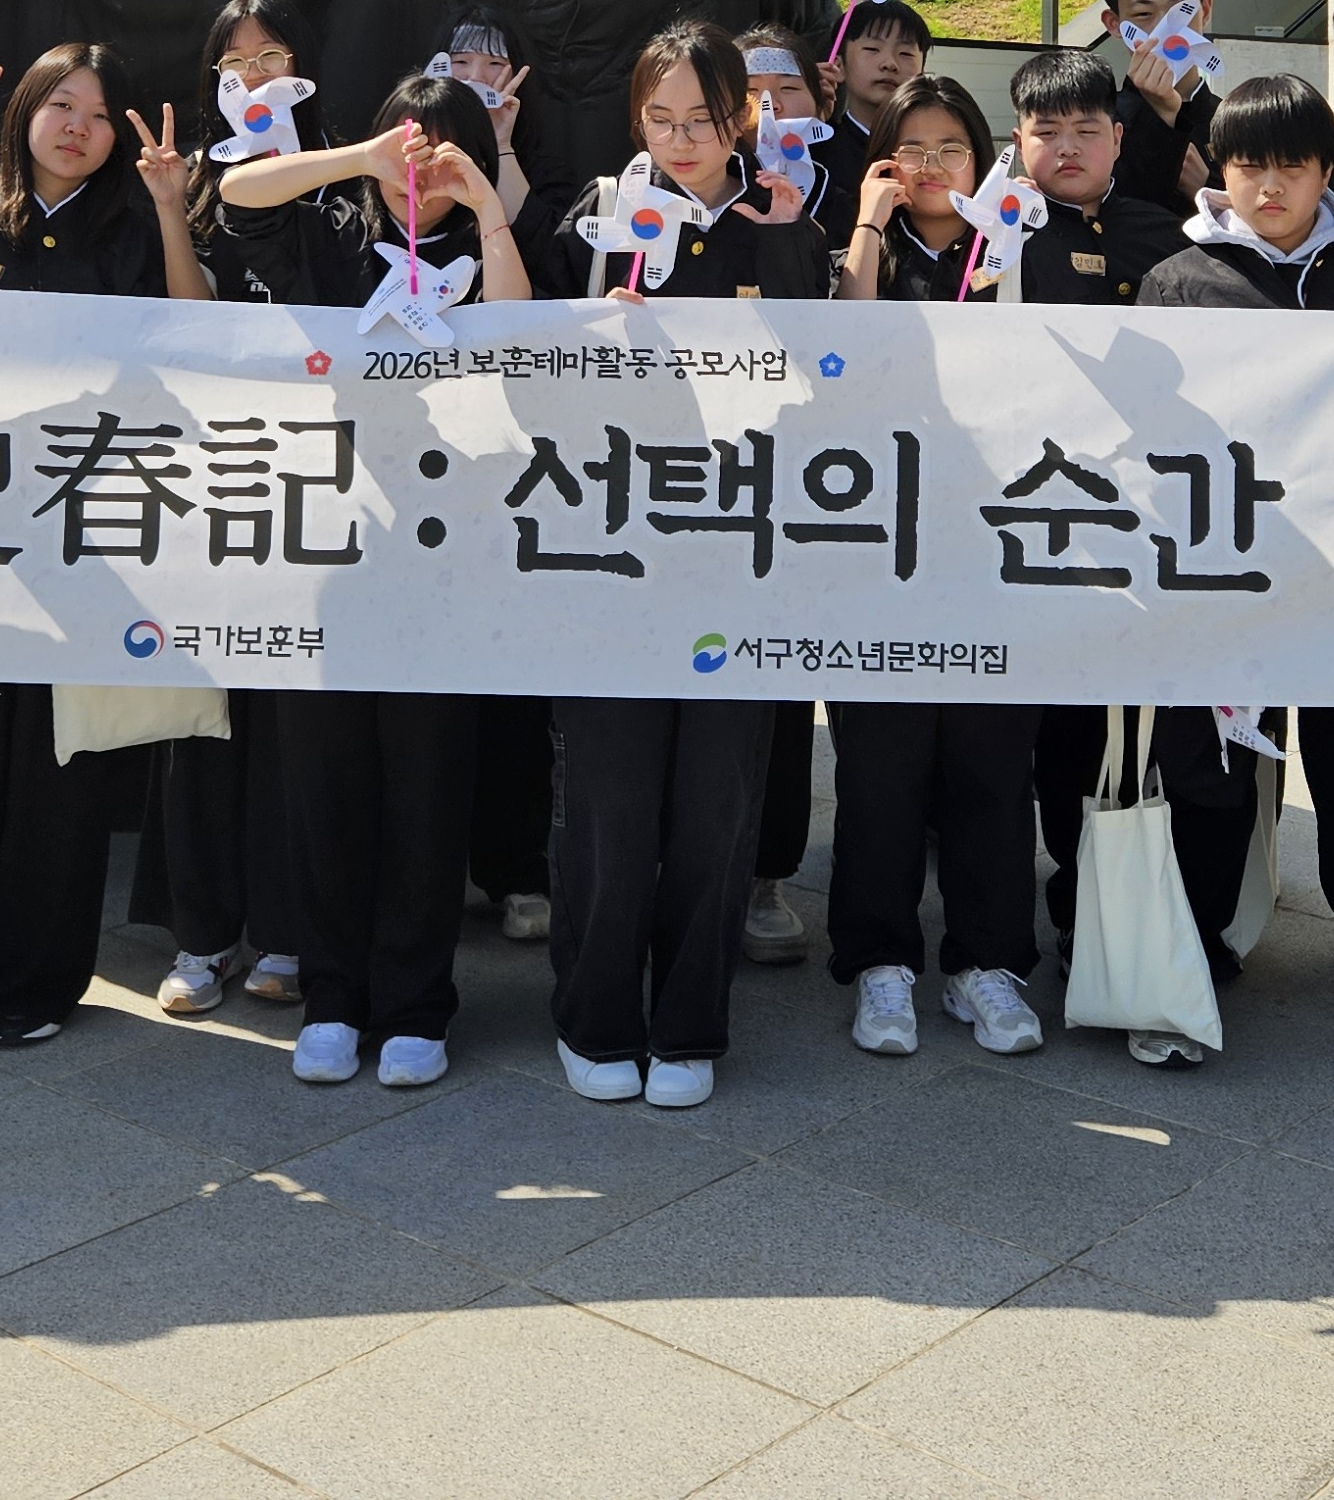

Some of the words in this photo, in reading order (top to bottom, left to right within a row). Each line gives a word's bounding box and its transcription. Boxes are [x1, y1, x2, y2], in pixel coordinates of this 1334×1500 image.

[363, 348, 462, 381] 2026년
[466, 345, 658, 381] 보훈테마활동
[664, 348, 788, 382] 공모사업
[504, 425, 921, 581] 선택의
[980, 437, 1287, 593] 순간
[173, 625, 325, 658] 국가보훈부
[733, 637, 1009, 675] 서구청소년문화의집
